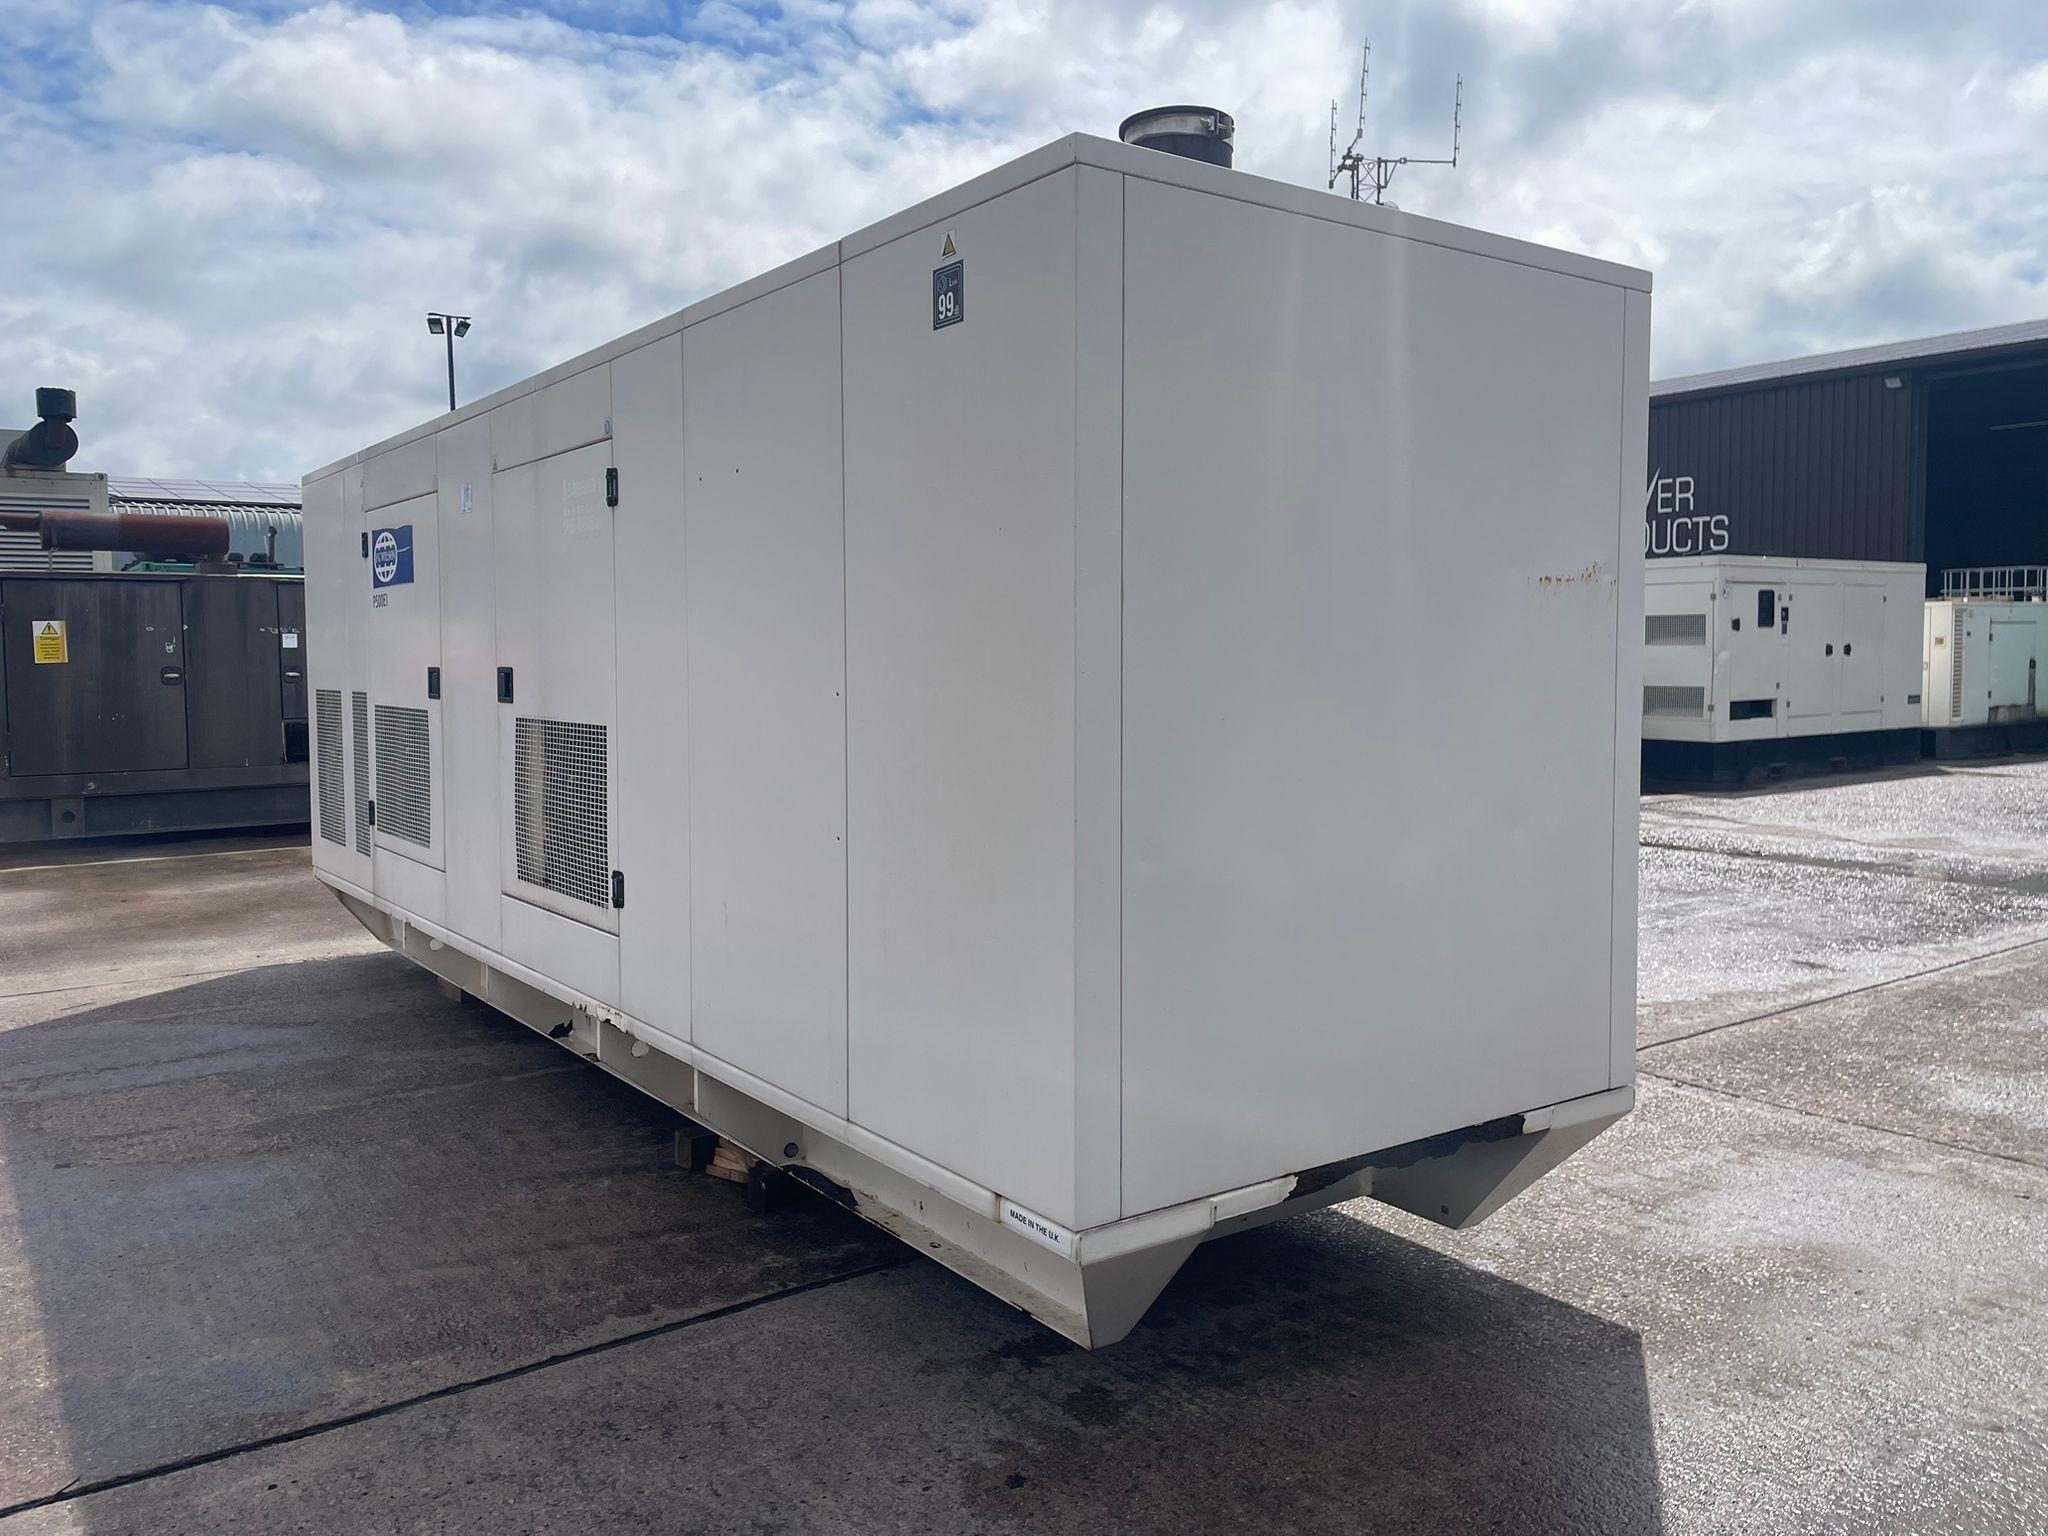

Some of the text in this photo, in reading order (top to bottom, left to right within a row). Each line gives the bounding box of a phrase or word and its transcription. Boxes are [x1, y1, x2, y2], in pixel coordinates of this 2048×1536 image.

[939, 292, 953, 319] 99
[1010, 1209, 1027, 1225] MADE
[1028, 1219, 1035, 1229] IN
[1035, 1223, 1047, 1236] THE
